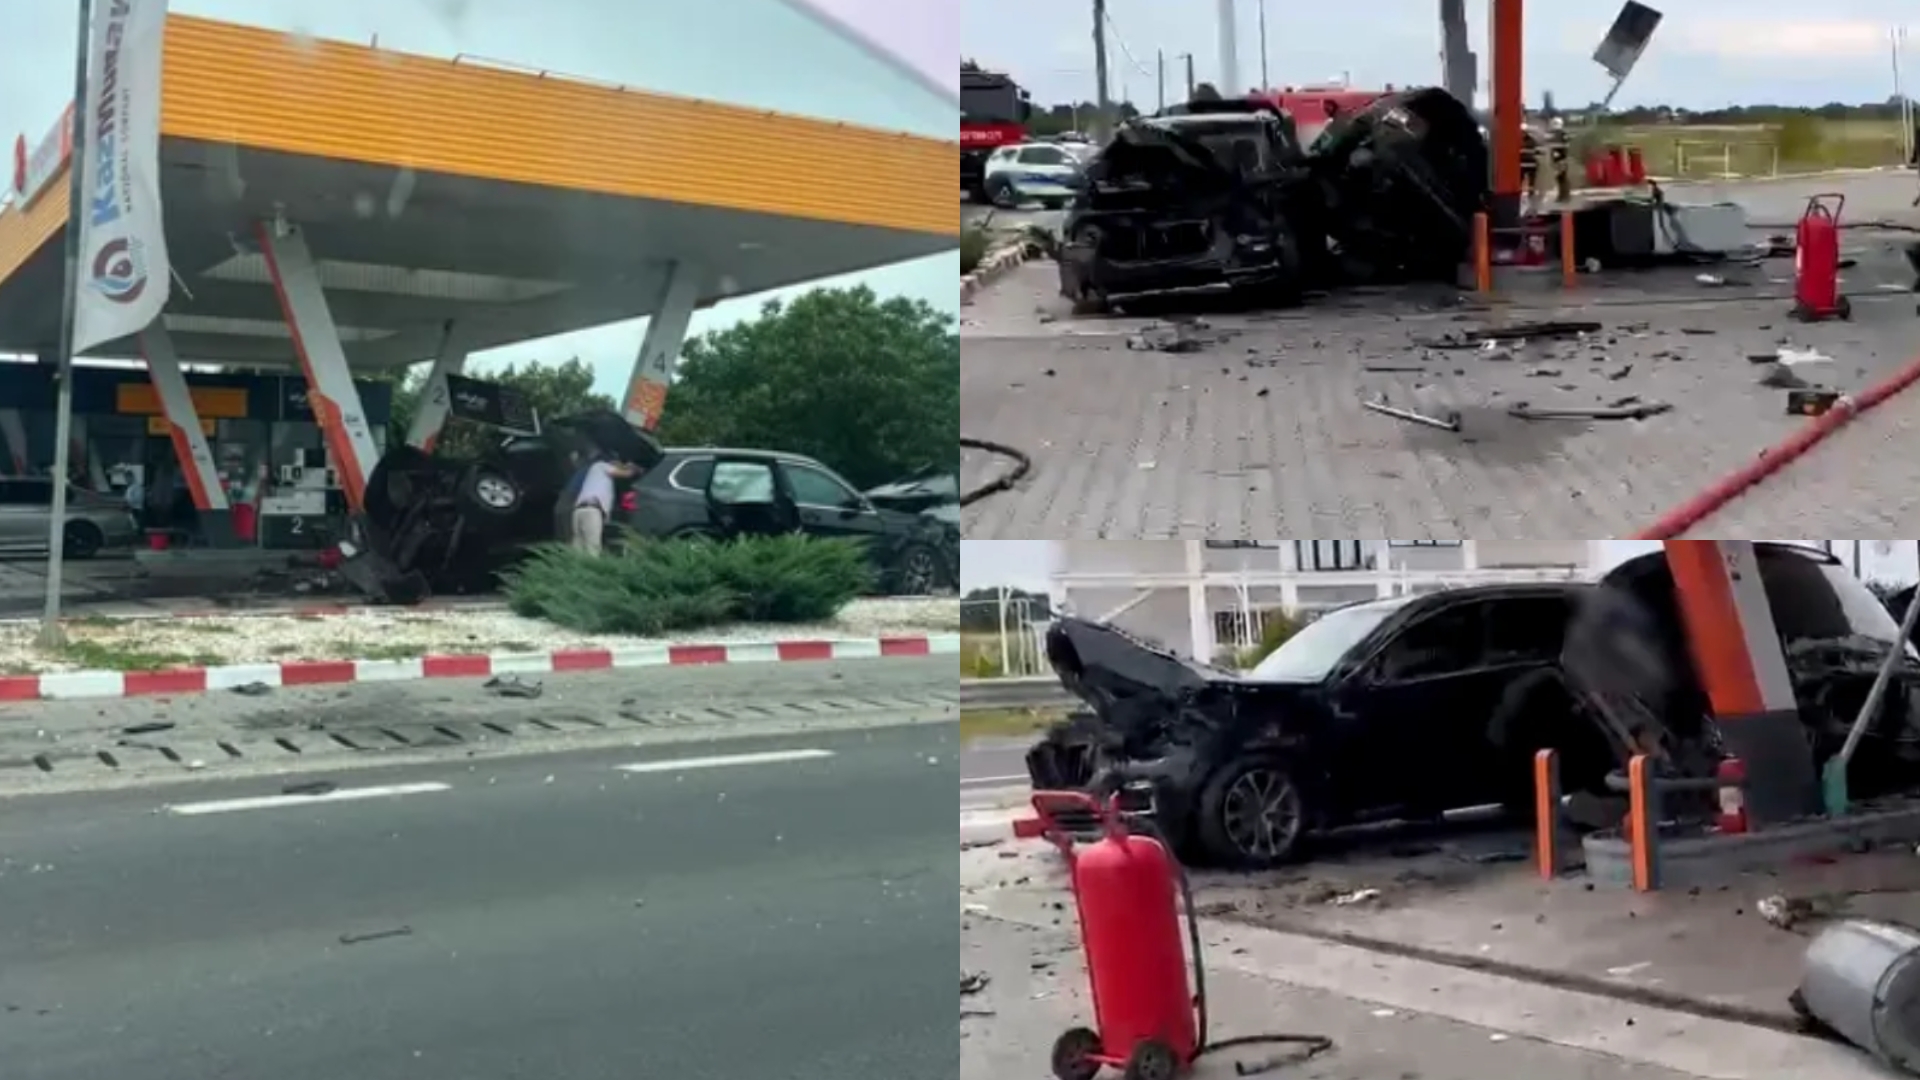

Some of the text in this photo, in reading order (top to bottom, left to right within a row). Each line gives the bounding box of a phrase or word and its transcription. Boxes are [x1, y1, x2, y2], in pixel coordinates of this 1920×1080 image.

[652, 350, 666, 375] 4
[432, 385, 447, 405] 2
[291, 515, 304, 535] 2
